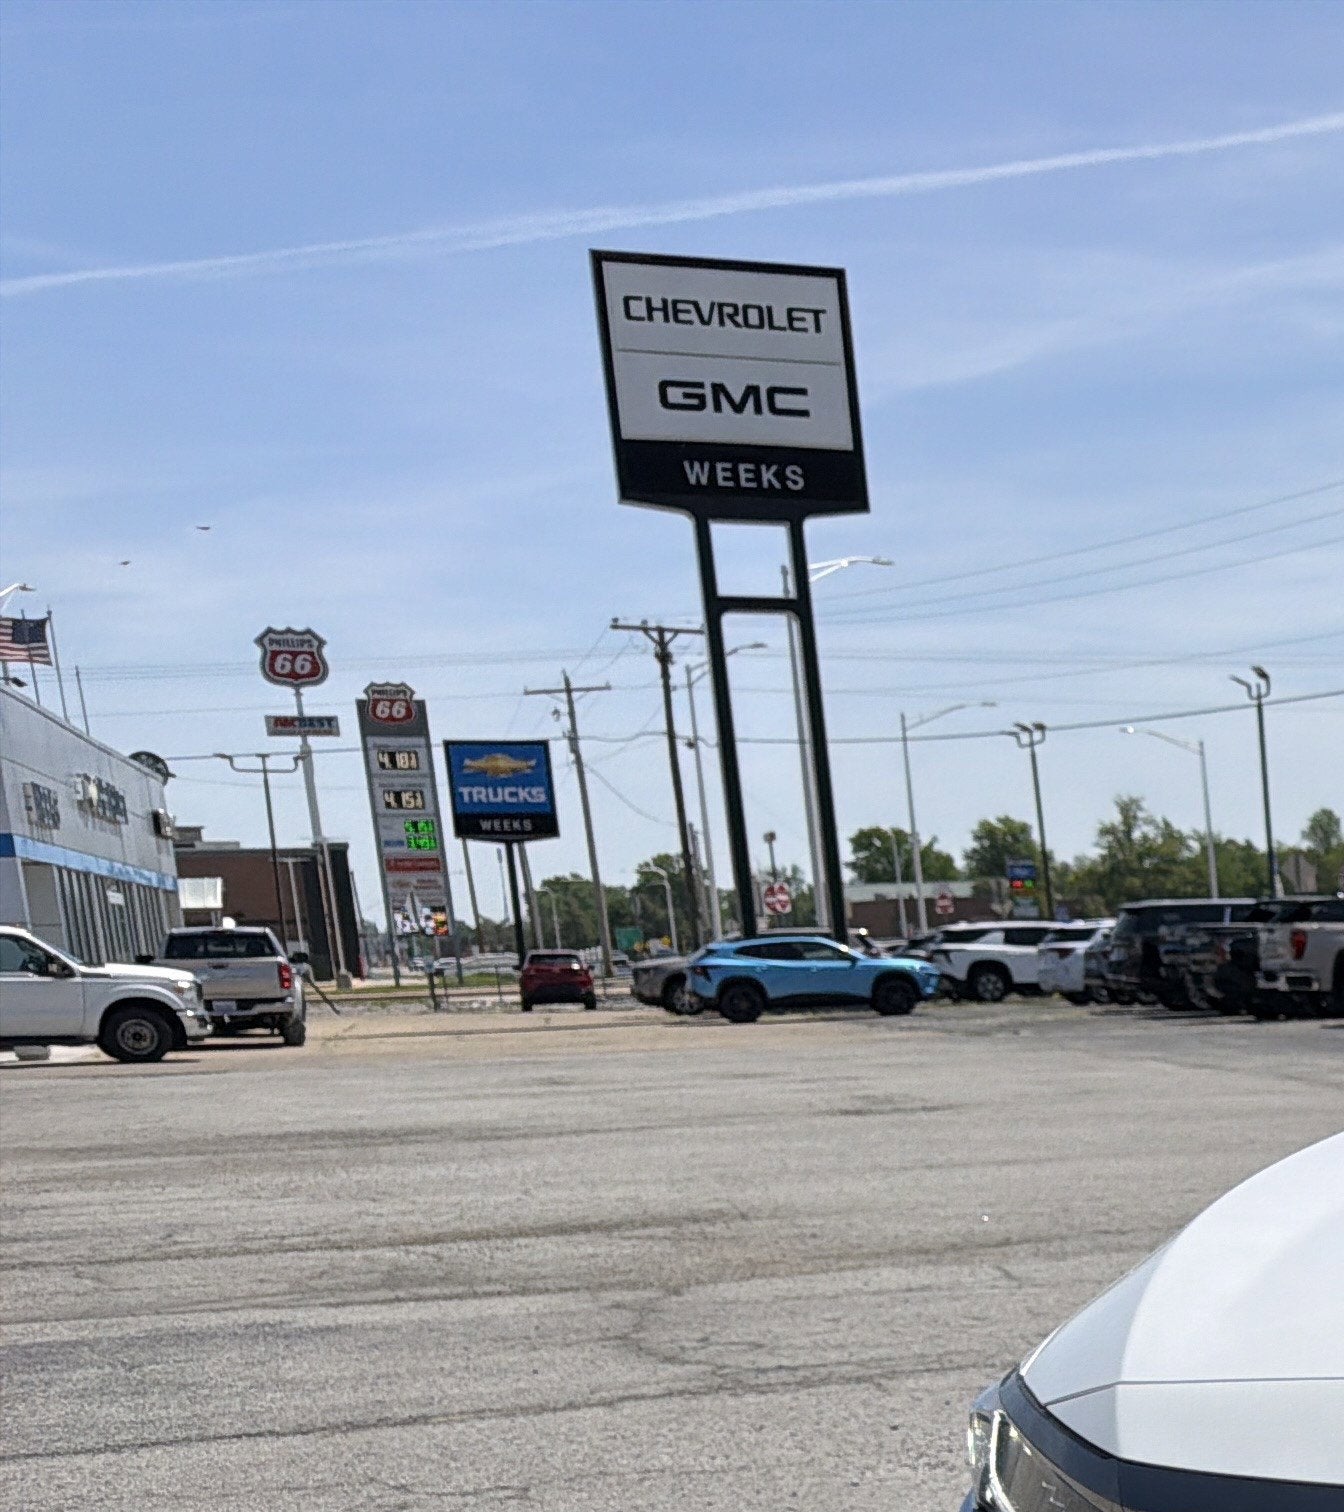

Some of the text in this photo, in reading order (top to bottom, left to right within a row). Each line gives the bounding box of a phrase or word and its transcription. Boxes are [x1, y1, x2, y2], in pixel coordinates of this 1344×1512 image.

[622, 294, 827, 334] CHEVROLET
[657, 378, 811, 419] GMC
[682, 459, 806, 492] WEEKS
[268, 638, 315, 648] PHILLIPS
[275, 653, 313, 675] 66
[375, 700, 407, 719] 66
[459, 786, 547, 804] TRUCKS
[480, 819, 533, 832] WEEKS
